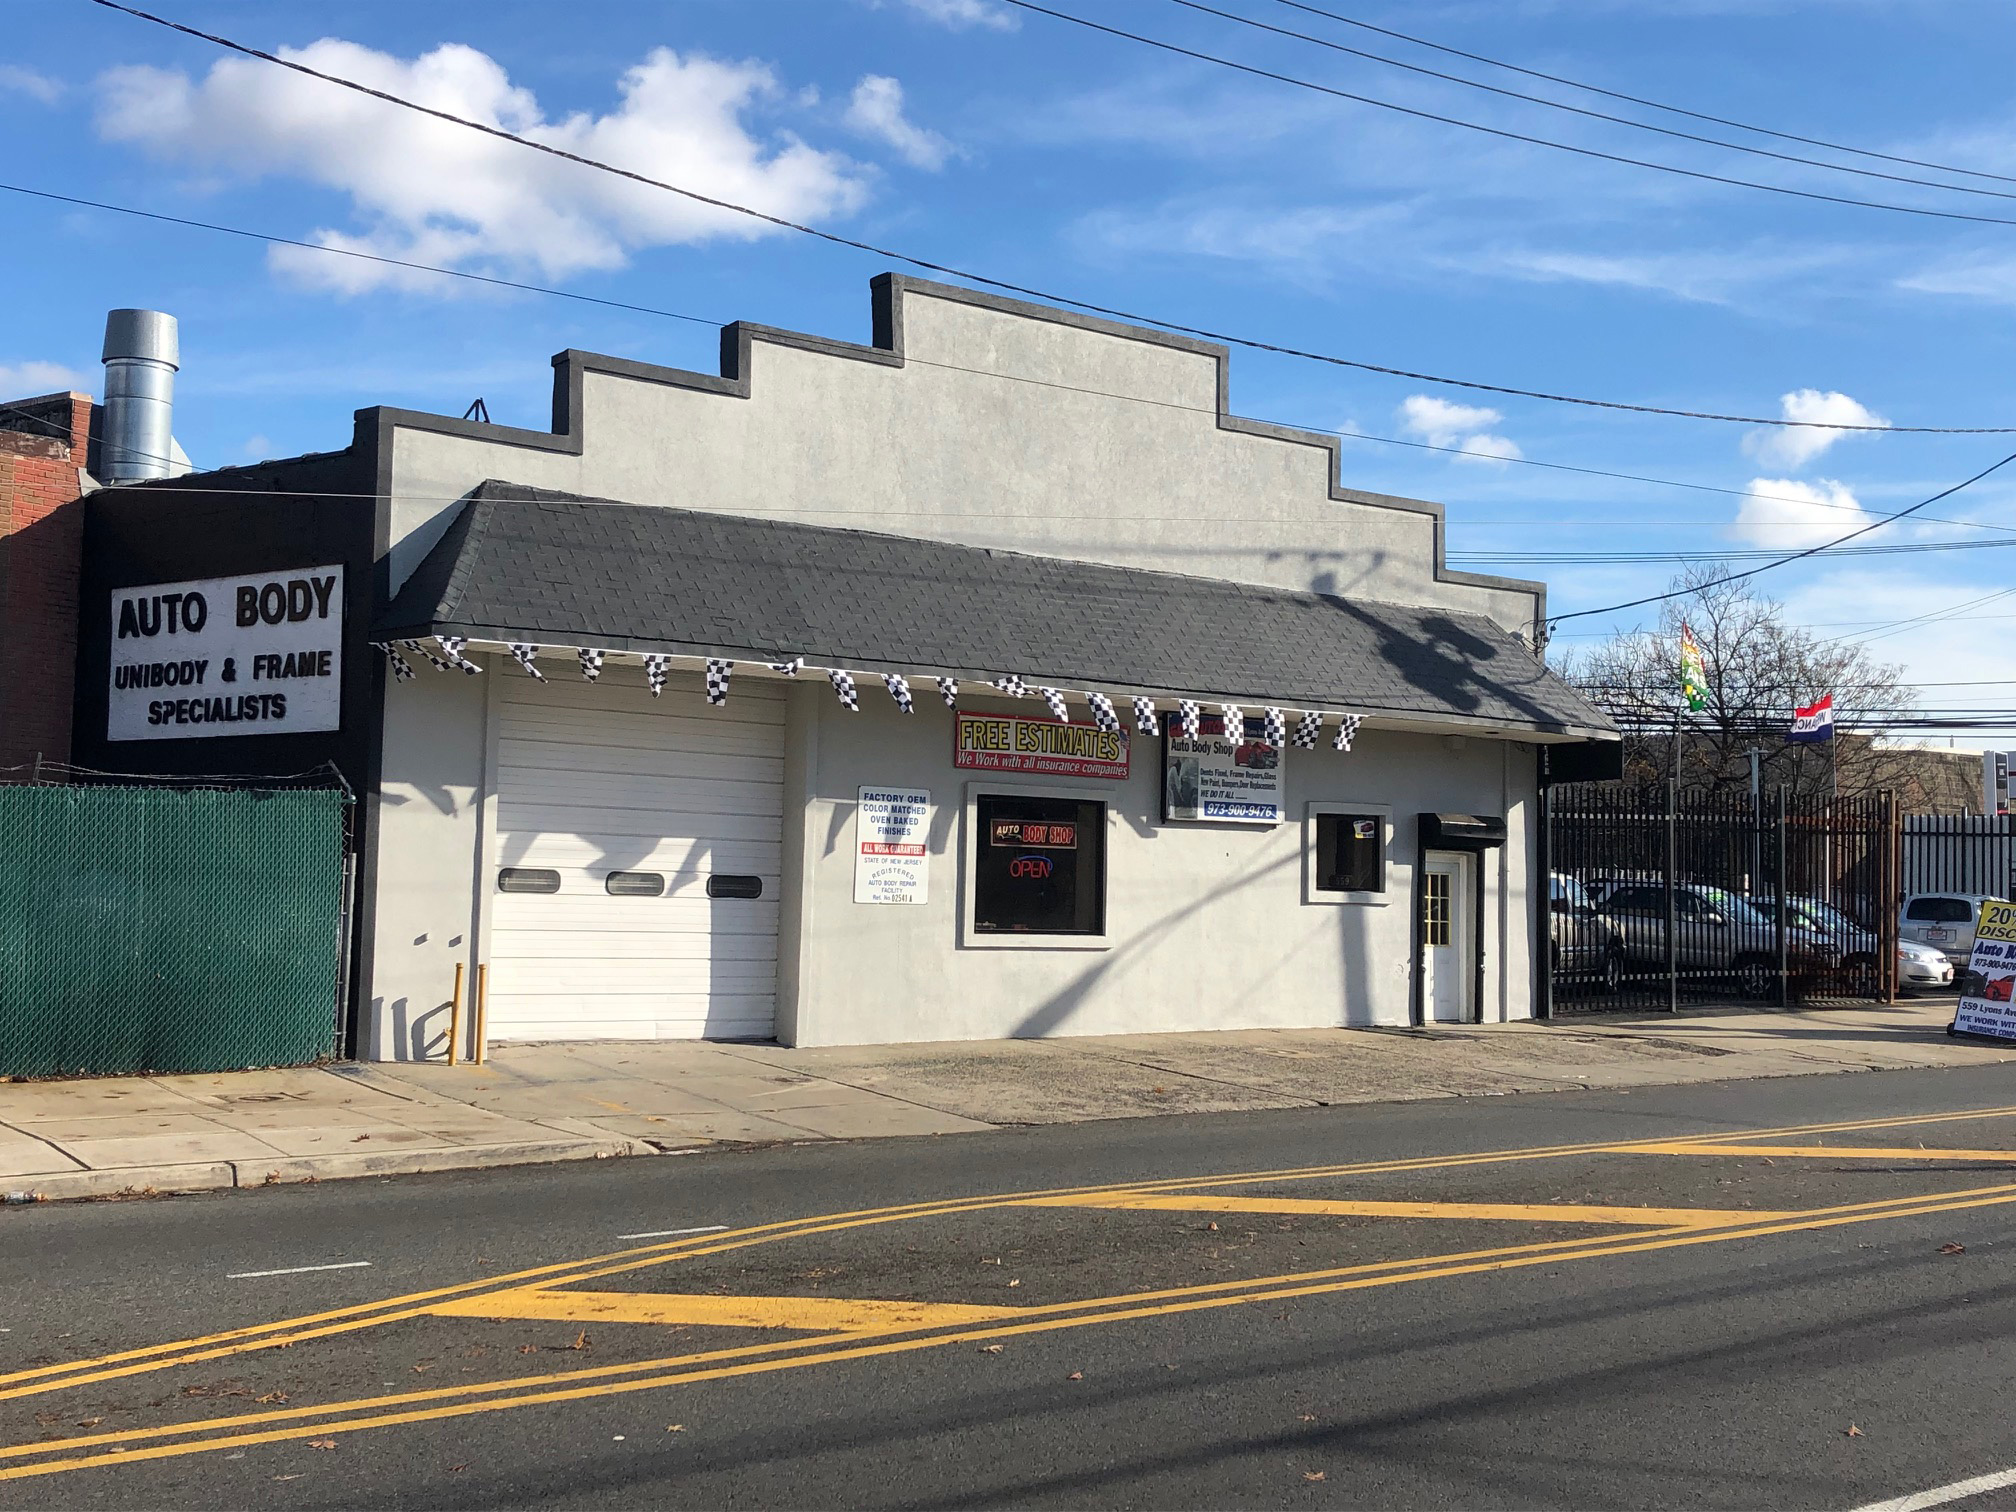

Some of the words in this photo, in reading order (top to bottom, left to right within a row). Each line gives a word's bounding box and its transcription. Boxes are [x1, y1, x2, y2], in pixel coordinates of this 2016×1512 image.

[118, 591, 207, 639] AUTO
[236, 575, 337, 627] BODY
[114, 659, 209, 690] UNIBODY
[221, 657, 236, 683] &
[252, 650, 332, 680] FRAME
[147, 693, 287, 725] SPECIALISTS
[960, 720, 1010, 750] FREE
[1015, 722, 1120, 761] ESTIMATES
[1171, 739, 1190, 752] Auto
[1192, 740, 1211, 756] Body
[1213, 741, 1233, 757] Shop
[958, 752, 972, 765] We
[975, 753, 999, 766] Work
[1001, 755, 1022, 768] with
[1023, 756, 1035, 769] all
[1037, 757, 1080, 772] insurance
[1082, 763, 1127, 776] companies
[864, 793, 904, 803] FACTORY
[907, 795, 926, 804] OEM
[1201, 789, 1210, 798] WE
[1210, 790, 1218, 798] DO
[1218, 790, 1225, 798] IT
[1225, 791, 1234, 799] ALL
[863, 804, 889, 813] COLOR
[891, 805, 926, 815] MATCHED
[1207, 803, 1272, 817] 973-900-9476
[870, 815, 891, 824] OVEN
[894, 817, 919, 825] BAKED
[877, 827, 911, 836] FINISHES
[996, 825, 1020, 834] AUTO
[1022, 825, 1048, 842] BODY
[1049, 826, 1074, 844] SHOP
[863, 843, 873, 853] ALL
[874, 843, 889, 854] WORK
[890, 844, 924, 855] GUARANTEED
[872, 867, 914, 880] REGISTERED
[1009, 860, 1051, 878] OPEN
[1974, 941, 2003, 956] Auto
[1962, 1001, 1978, 1011] 559
[1979, 1004, 2002, 1014] Lyons
[1960, 1014, 1972, 1022] WE
[1974, 1016, 1998, 1026] WORK
[1967, 1024, 1997, 1035] INSURANCE
